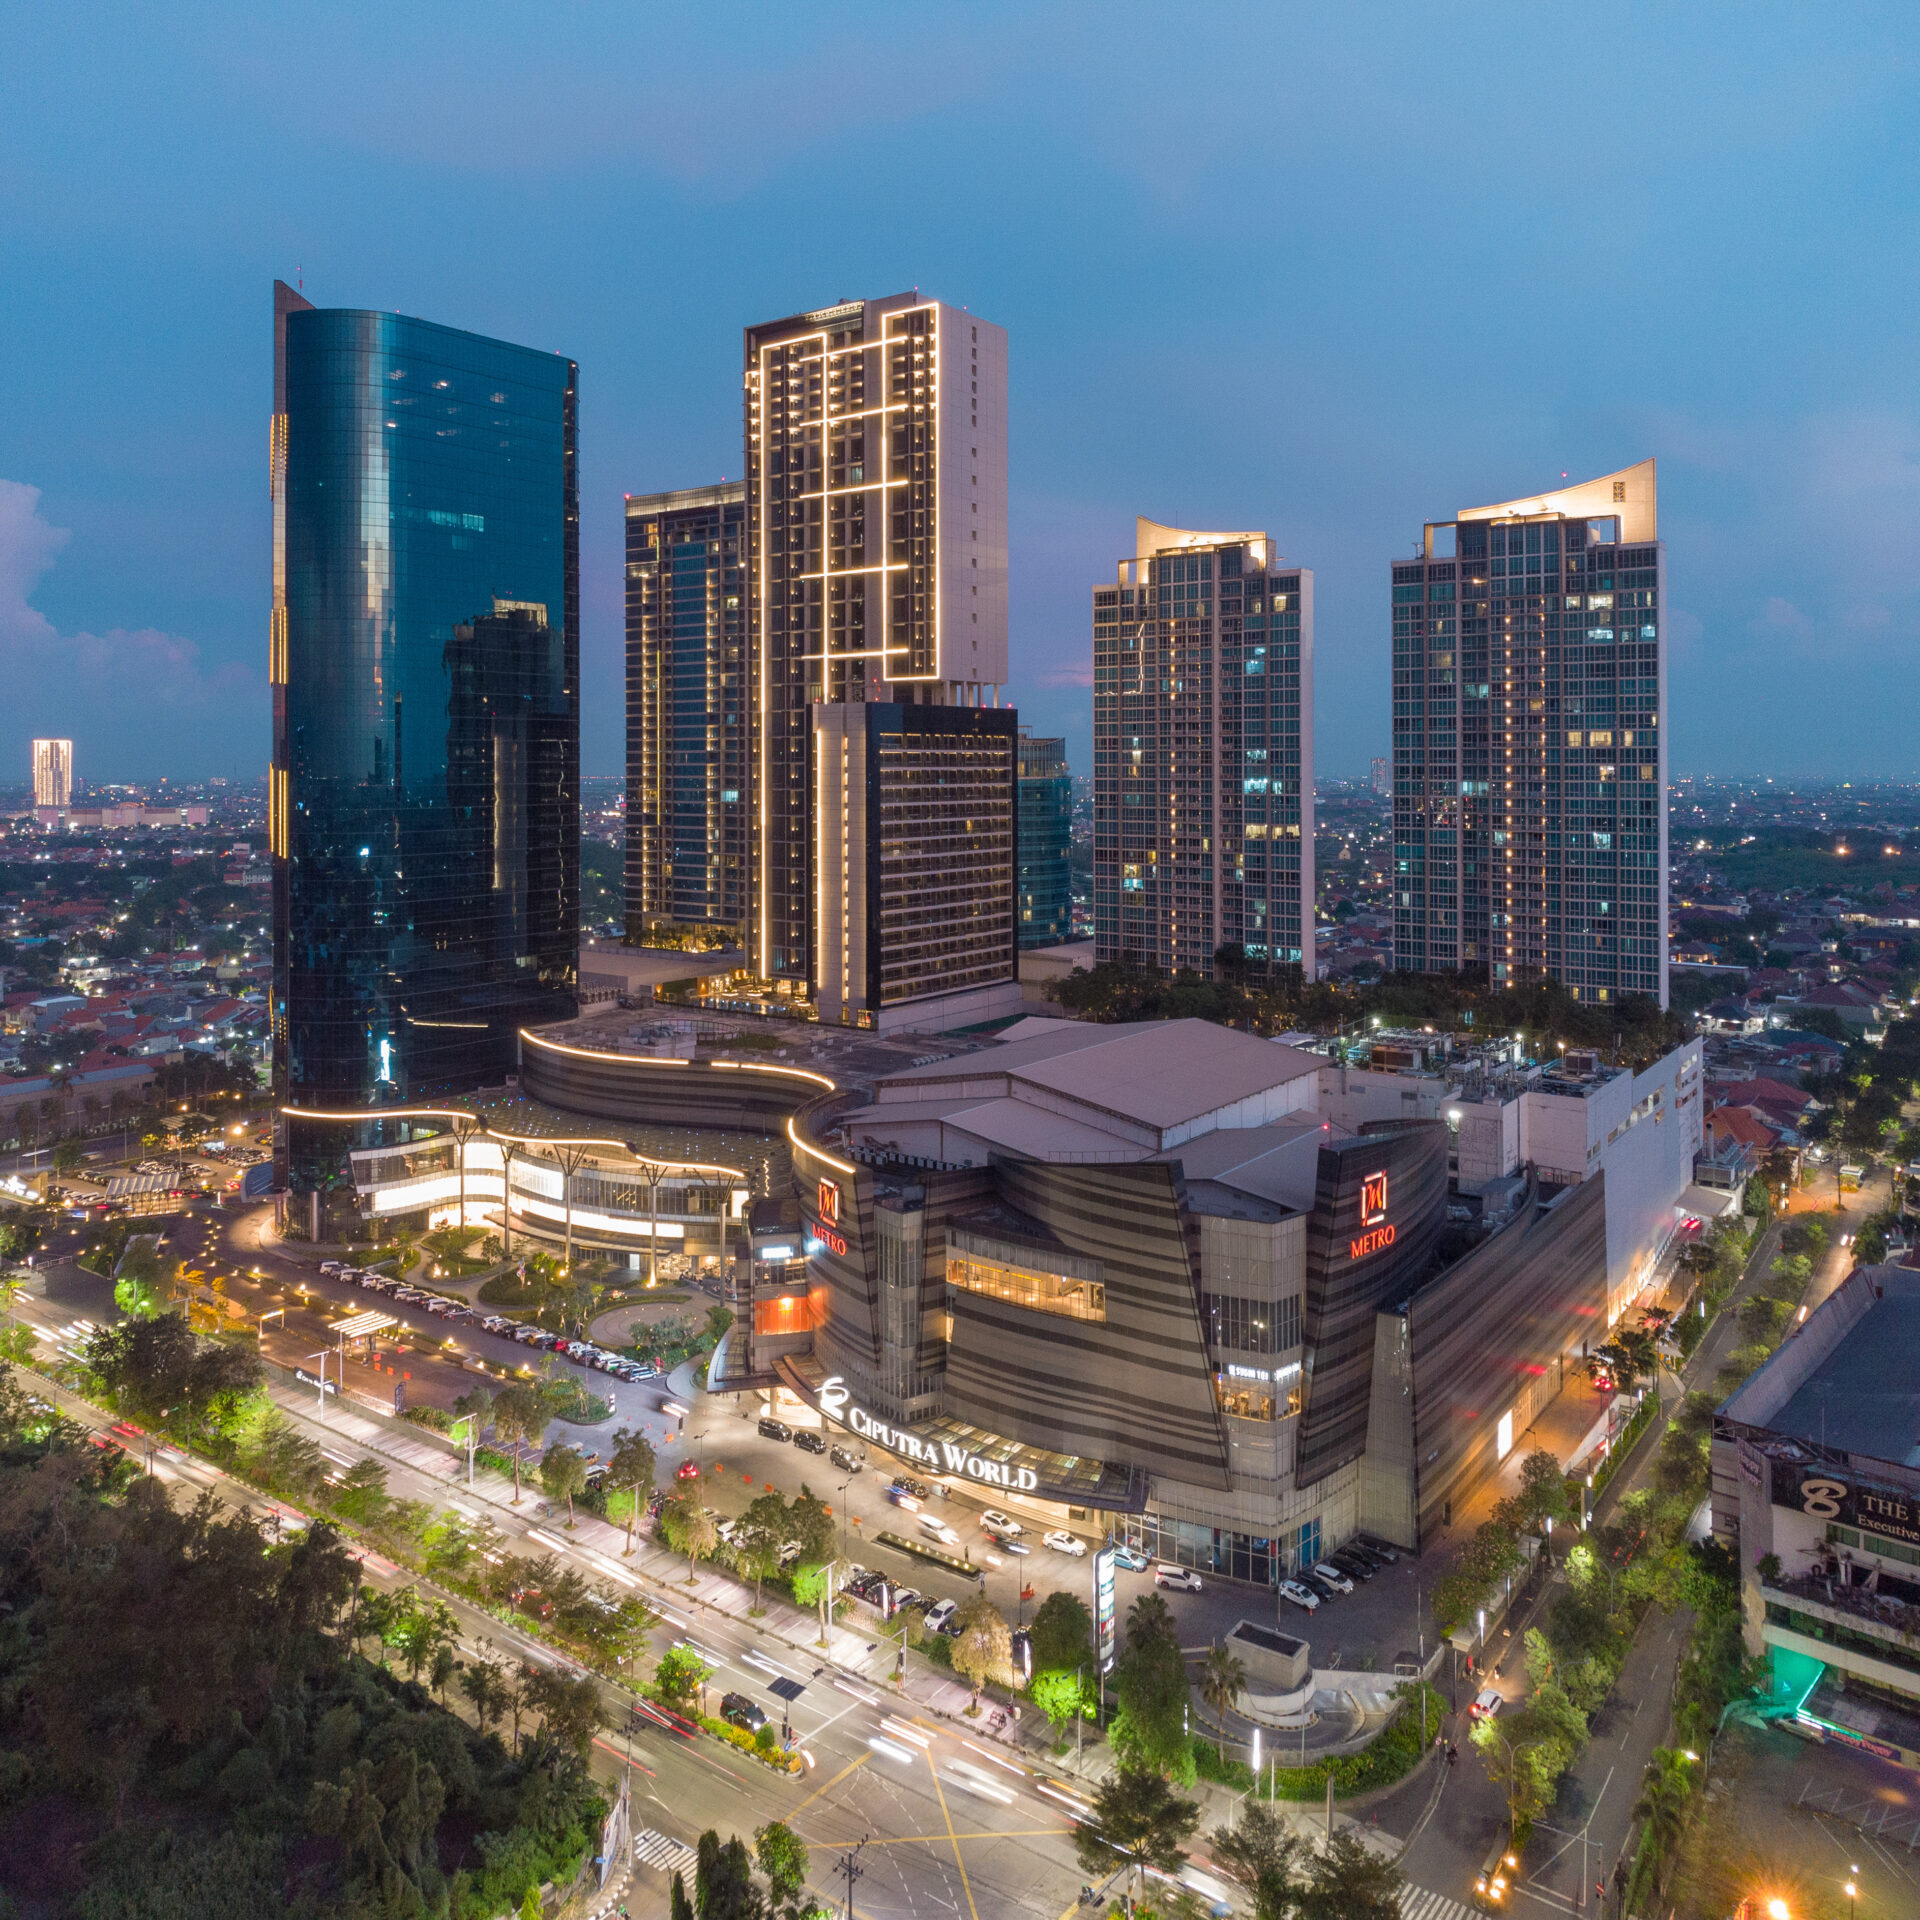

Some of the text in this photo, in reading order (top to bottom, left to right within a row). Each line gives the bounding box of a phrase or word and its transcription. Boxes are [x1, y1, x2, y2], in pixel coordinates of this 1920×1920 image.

[813, 1222, 847, 1256] METRO
[1351, 1224, 1395, 1259] METRO
[850, 1407, 1037, 1490] CIPUTRA WORLD
[1863, 1495, 1909, 1520] THE
[1857, 1513, 1920, 1540] Executive
